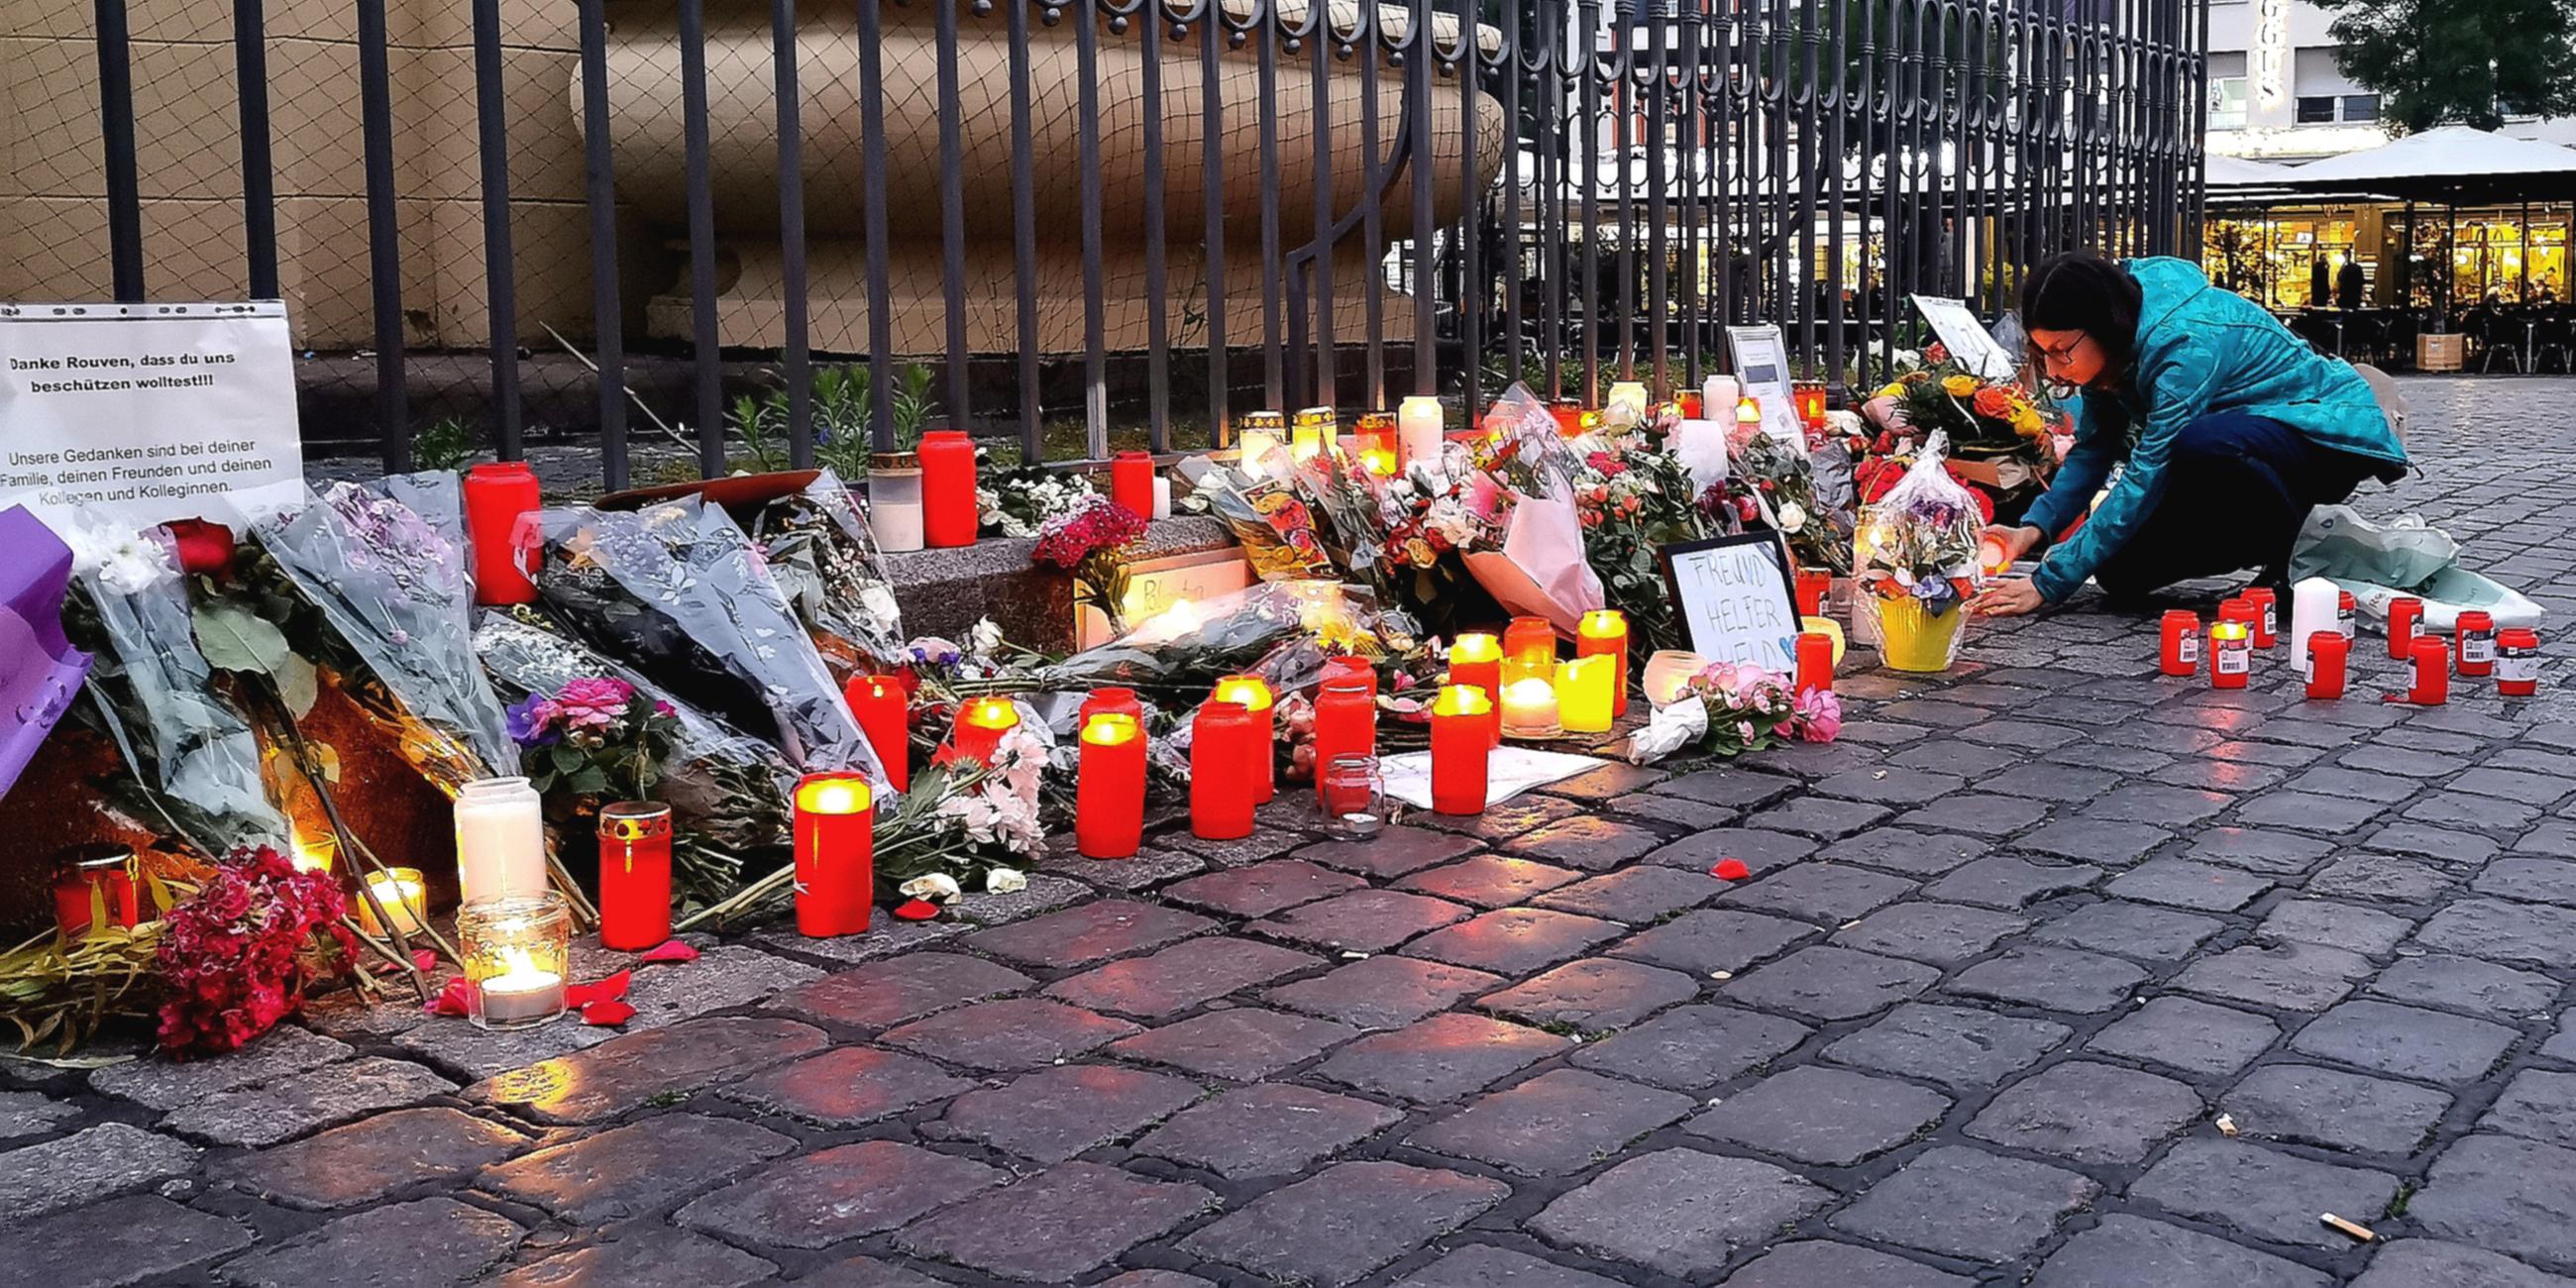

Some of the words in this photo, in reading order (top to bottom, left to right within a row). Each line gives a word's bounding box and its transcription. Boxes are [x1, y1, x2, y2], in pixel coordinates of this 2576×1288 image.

[9, 357, 60, 371] Danke
[66, 356, 135, 369] Rouven,
[140, 354, 174, 367] dass
[180, 353, 198, 366] du
[204, 353, 235, 365] uns
[31, 378, 131, 392] beschützen
[136, 375, 213, 389] wolltest!!!
[9, 451, 59, 466] Unsere
[63, 447, 143, 463] Gedanken
[147, 444, 176, 459] sind
[180, 442, 204, 456] bei
[208, 440, 256, 454] deiner
[0, 471, 54, 486] Familie,
[56, 469, 107, 483] deinen
[112, 465, 182, 481] Freunden
[188, 461, 216, 476] und
[221, 458, 271, 473] deinen
[40, 490, 103, 507] Kollegen
[107, 486, 135, 501] und
[140, 481, 233, 499] Kolleginnen.
[1688, 554, 1767, 588] FREUND
[1704, 595, 1782, 635] HELFER
